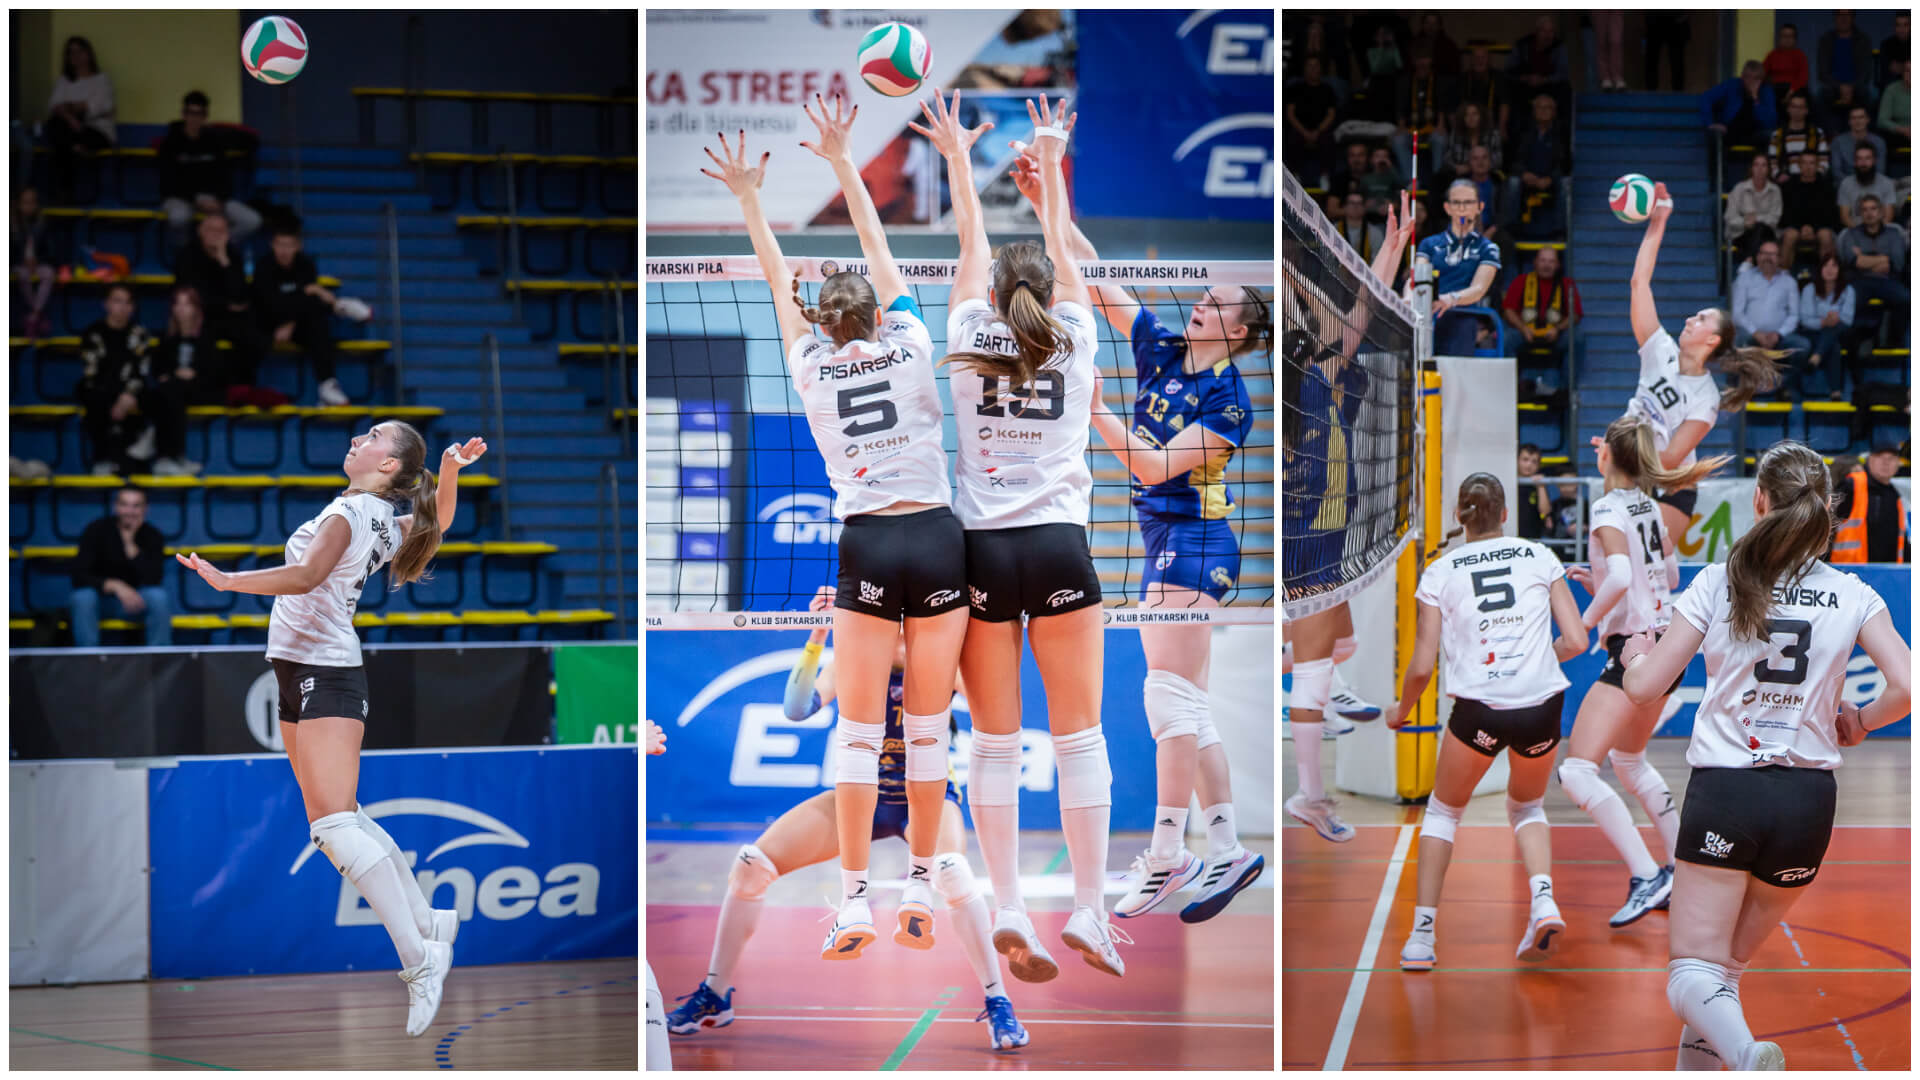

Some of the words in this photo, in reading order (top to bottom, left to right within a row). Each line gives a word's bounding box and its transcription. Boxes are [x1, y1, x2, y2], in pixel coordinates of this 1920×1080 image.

[697, 263, 724, 275] PIŁA
[1080, 267, 1106, 278] LUB
[1109, 266, 1179, 279] SIATKARSKI
[1181, 266, 1209, 279] PIŁA
[819, 347, 914, 381] PISARSKA
[976, 369, 1065, 420] 19
[1648, 376, 1680, 410] 19
[838, 380, 898, 437] 5
[1146, 392, 1170, 422] 13
[864, 434, 910, 451] KGHM
[997, 430, 1042, 441] KGHM
[1637, 519, 1665, 565] 14
[1452, 547, 1535, 569] PISARSKA
[1471, 566, 1516, 613] 5
[751, 617, 772, 625] KLUB
[775, 616, 823, 625] SIATKARSKI
[1116, 614, 1137, 622] KLUB
[1140, 613, 1188, 622] SIATKARSKI
[1191, 613, 1210, 621] PIŁA
[1754, 618, 1812, 685] 3
[1761, 692, 1804, 706] KGHM
